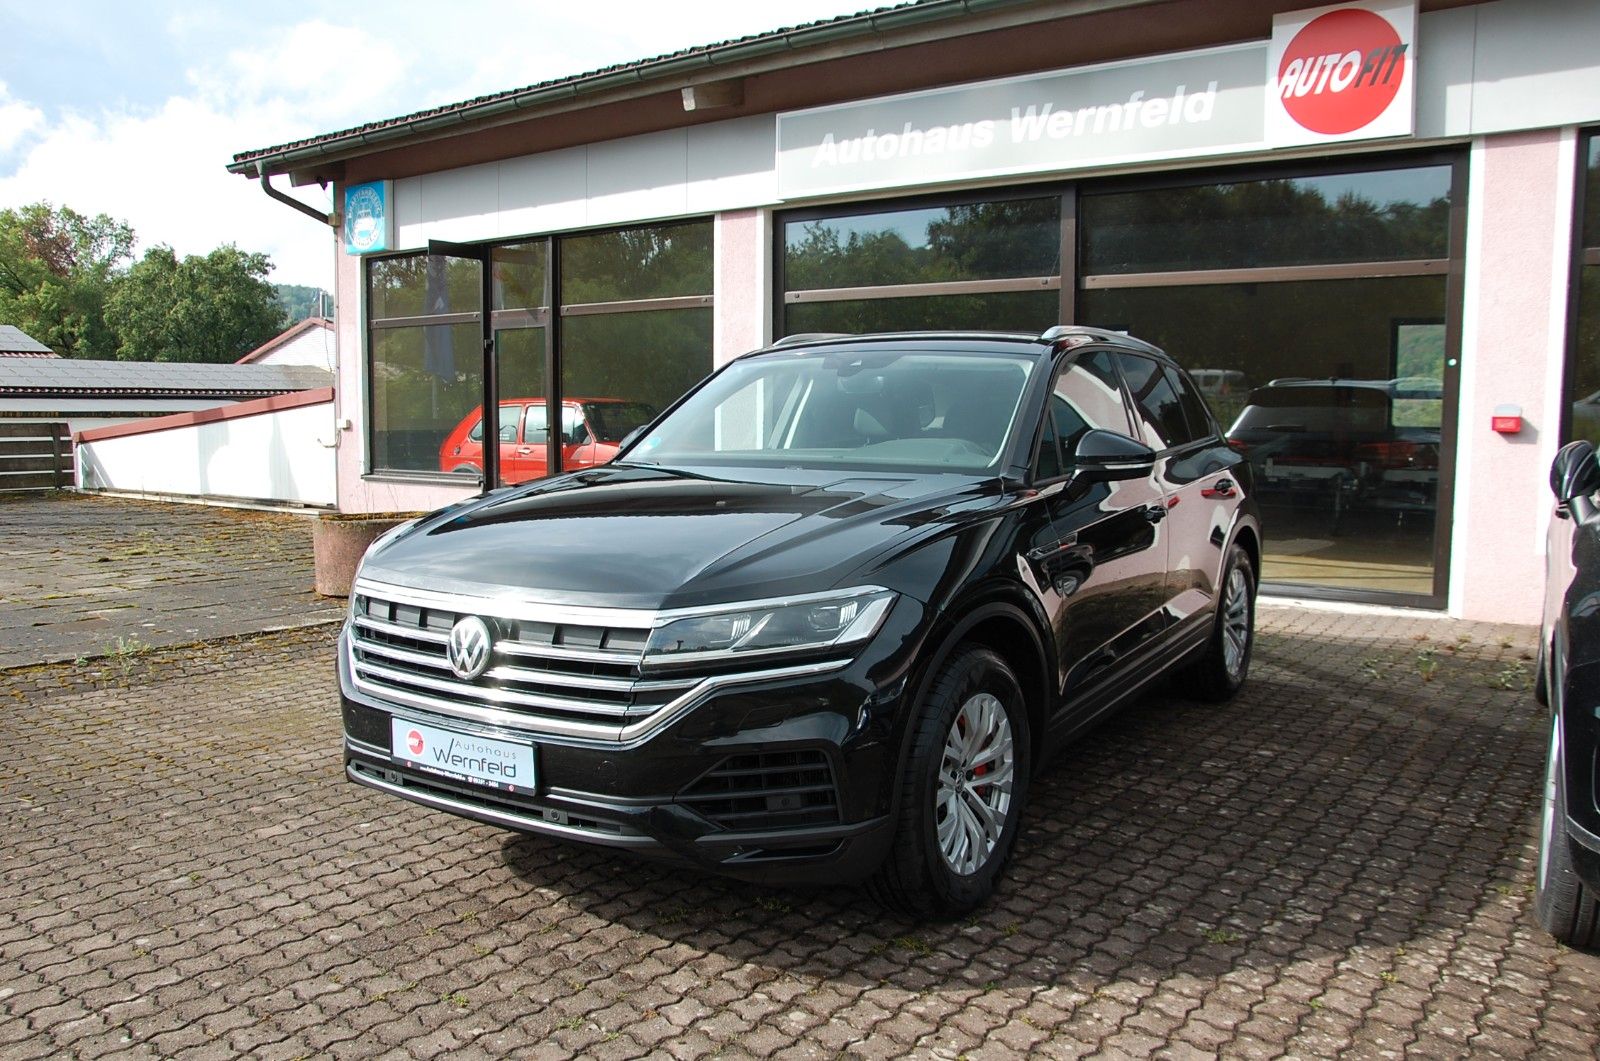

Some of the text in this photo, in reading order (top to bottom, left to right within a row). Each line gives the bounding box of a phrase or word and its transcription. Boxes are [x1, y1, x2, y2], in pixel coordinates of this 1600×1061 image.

[1278, 44, 1408, 99] AUTOFIT
[811, 80, 1218, 169] Autohaus Wernfeld
[432, 738, 517, 778] Wernfeld
[455, 740, 517, 760] Autohaus
